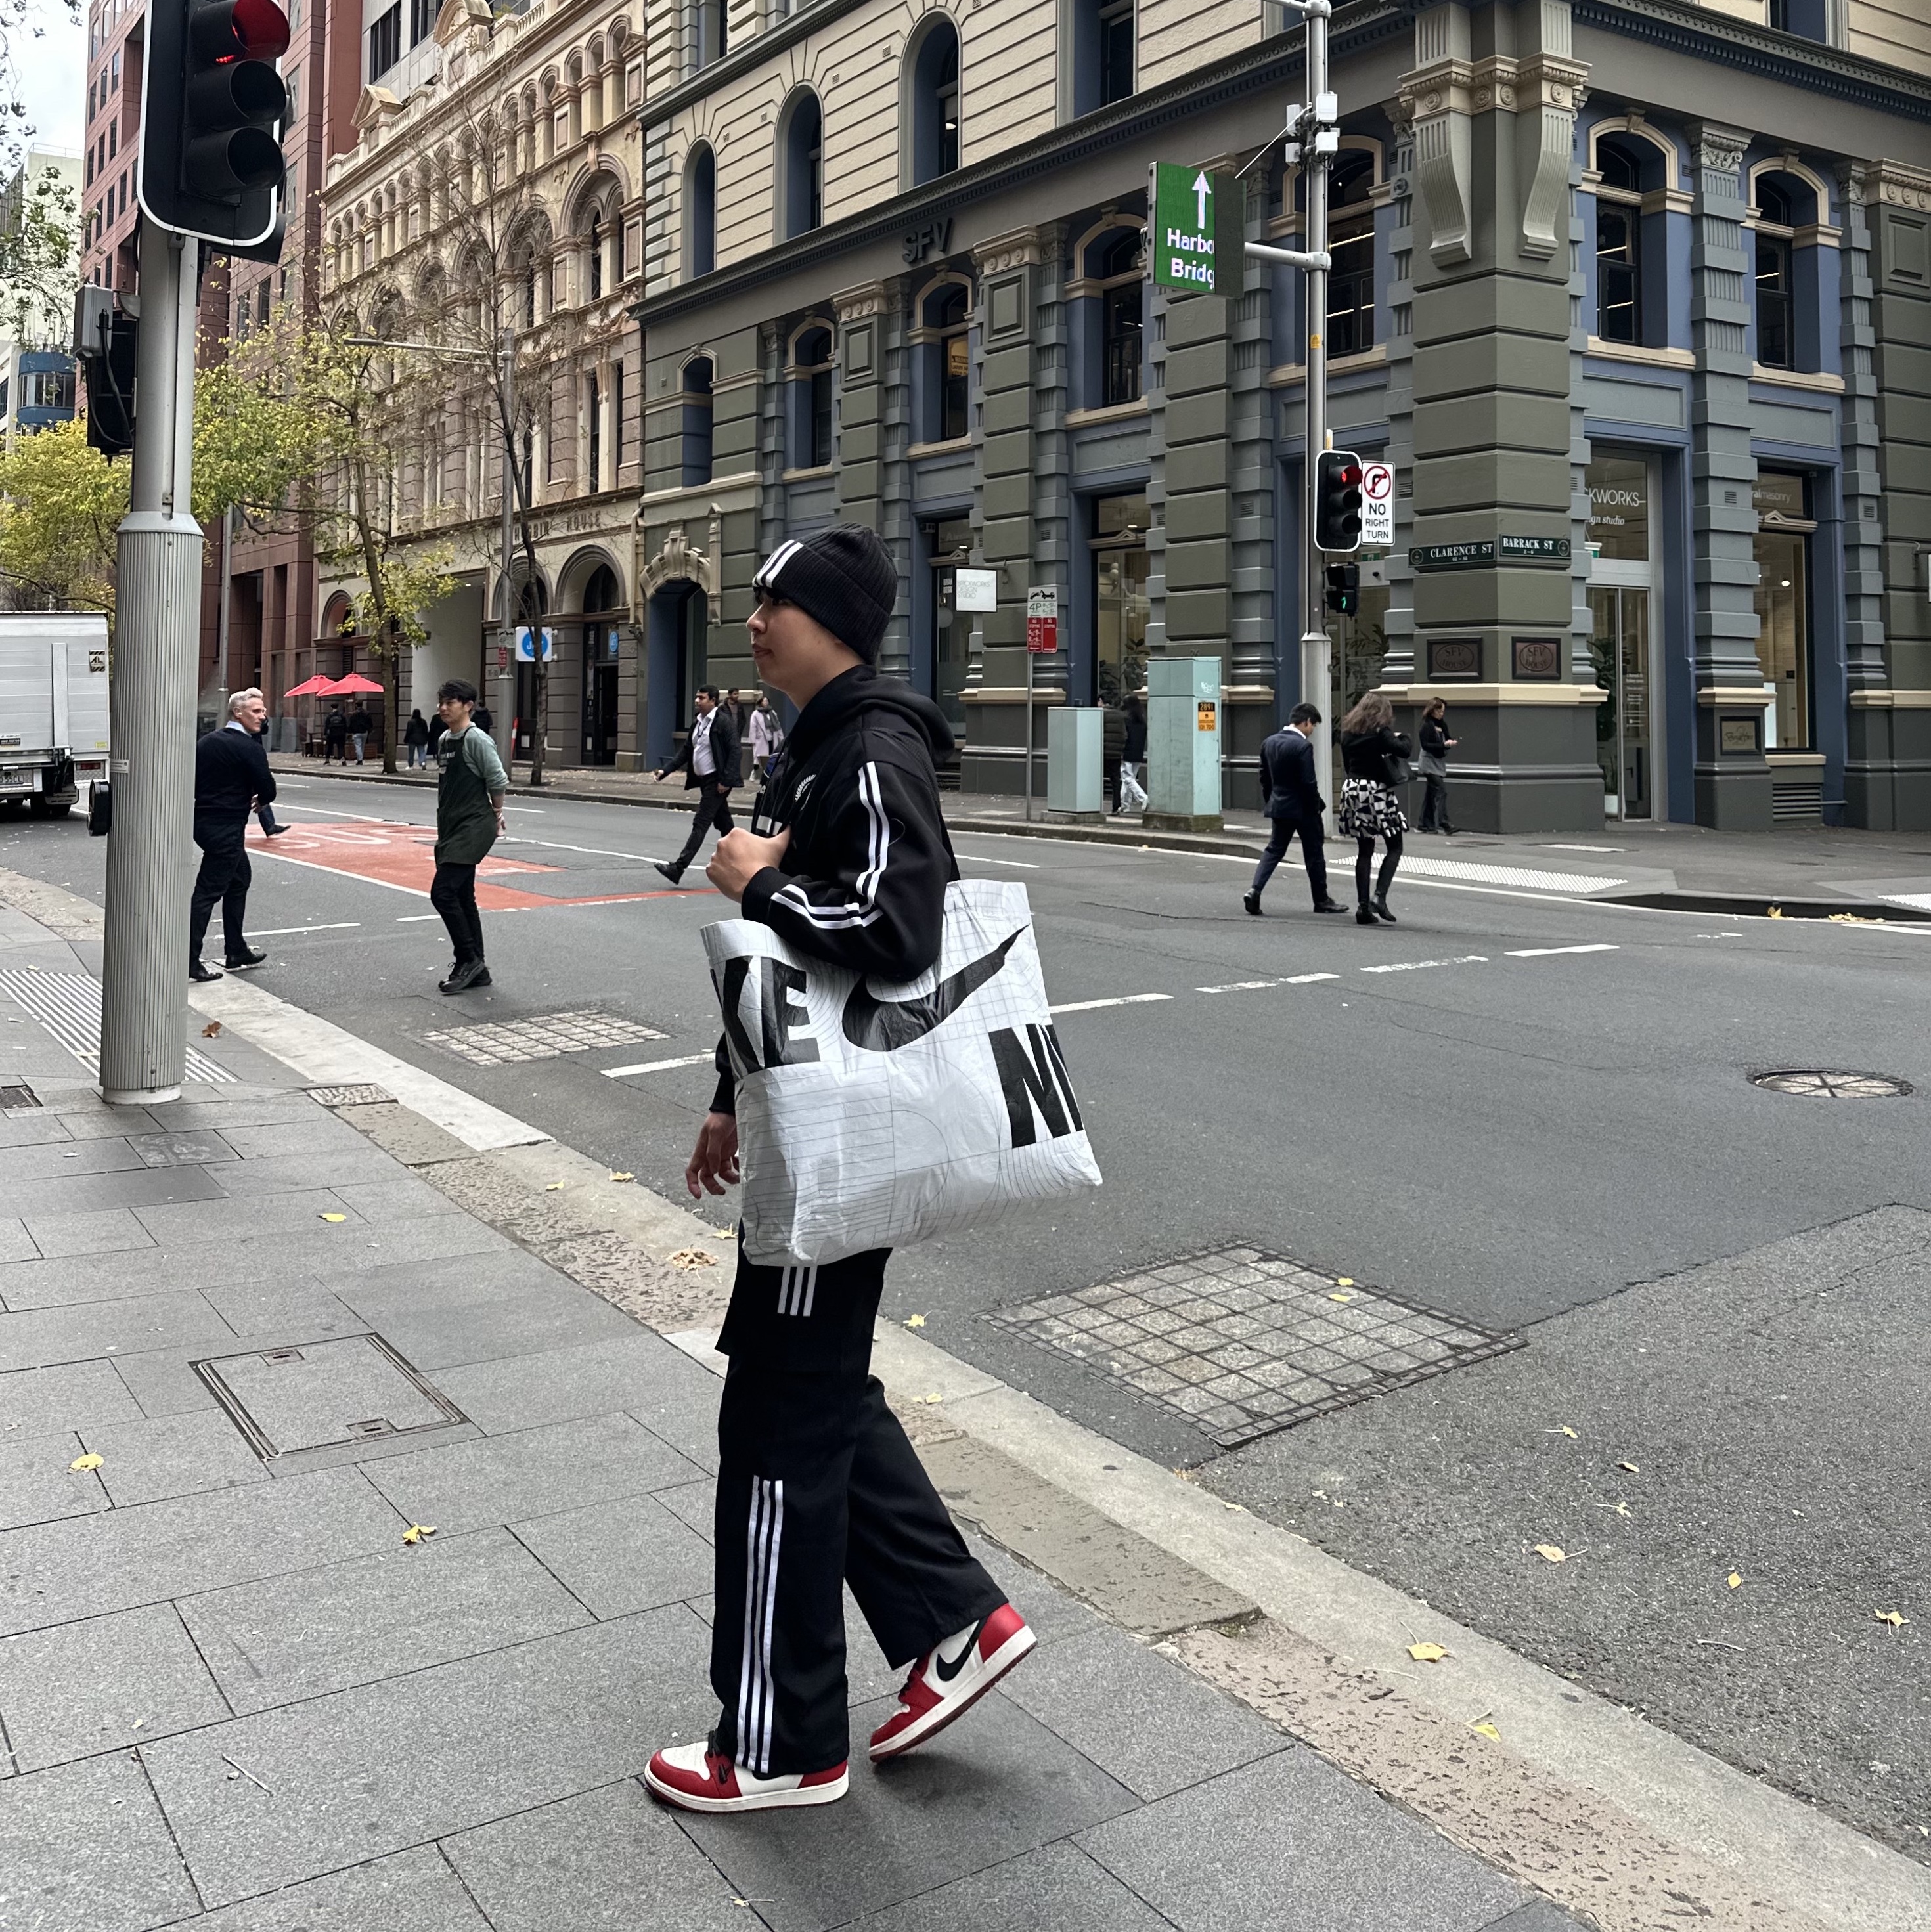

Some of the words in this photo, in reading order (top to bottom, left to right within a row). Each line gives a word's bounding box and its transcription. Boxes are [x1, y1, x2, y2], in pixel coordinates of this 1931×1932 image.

[902, 217, 953, 263] SFV
[1369, 503, 1386, 516] NO
[566, 511, 600, 533] HOUSE
[1365, 518, 1389, 527] RIGHT
[1602, 515, 1625, 525] studio
[1367, 530, 1388, 538] TURN
[1503, 538, 1540, 549] BARRACK
[1543, 540, 1553, 550] ST
[1430, 545, 1477, 558] CLARENCE
[1481, 544, 1493, 553] ST
[1445, 646, 1465, 657] SFV
[1528, 646, 1545, 657] SFV
